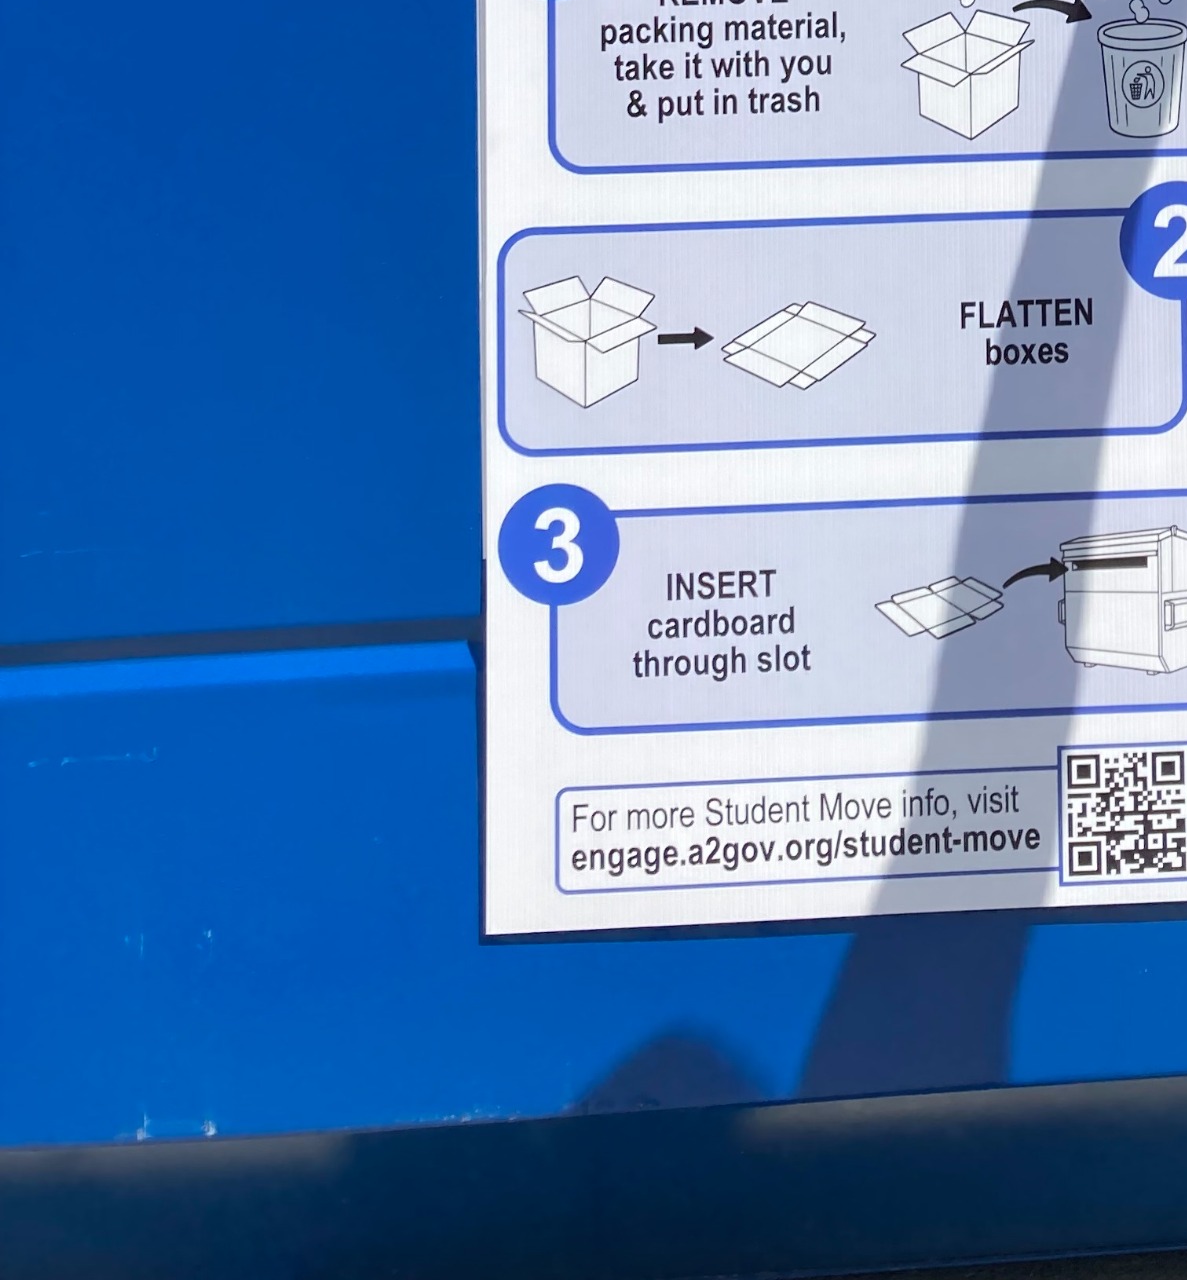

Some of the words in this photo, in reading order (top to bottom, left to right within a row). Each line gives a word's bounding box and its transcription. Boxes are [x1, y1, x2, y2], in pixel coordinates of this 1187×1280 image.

[599, 16, 714, 53] packing
[724, 12, 847, 46] material,
[614, 53, 674, 82] take
[686, 51, 703, 81] it
[710, 49, 771, 80] with
[780, 54, 833, 86] you
[626, 90, 648, 118] &
[658, 91, 705, 122] put
[713, 87, 739, 116] in
[749, 85, 821, 114] trash
[959, 298, 1094, 330] FLATTEN
[985, 337, 1070, 366] boxes
[533, 506, 585, 585] 3
[665, 569, 777, 601] INSERT
[647, 608, 796, 641] cardboard
[632, 644, 748, 682] through
[756, 643, 812, 673] slot
[571, 803, 617, 834] For
[625, 806, 695, 832] more
[704, 794, 811, 828] Student
[819, 792, 892, 823] Move
[901, 787, 959, 822] info,
[967, 784, 1020, 816] visit
[571, 826, 1041, 875] engage.a2gov.org/student-move
